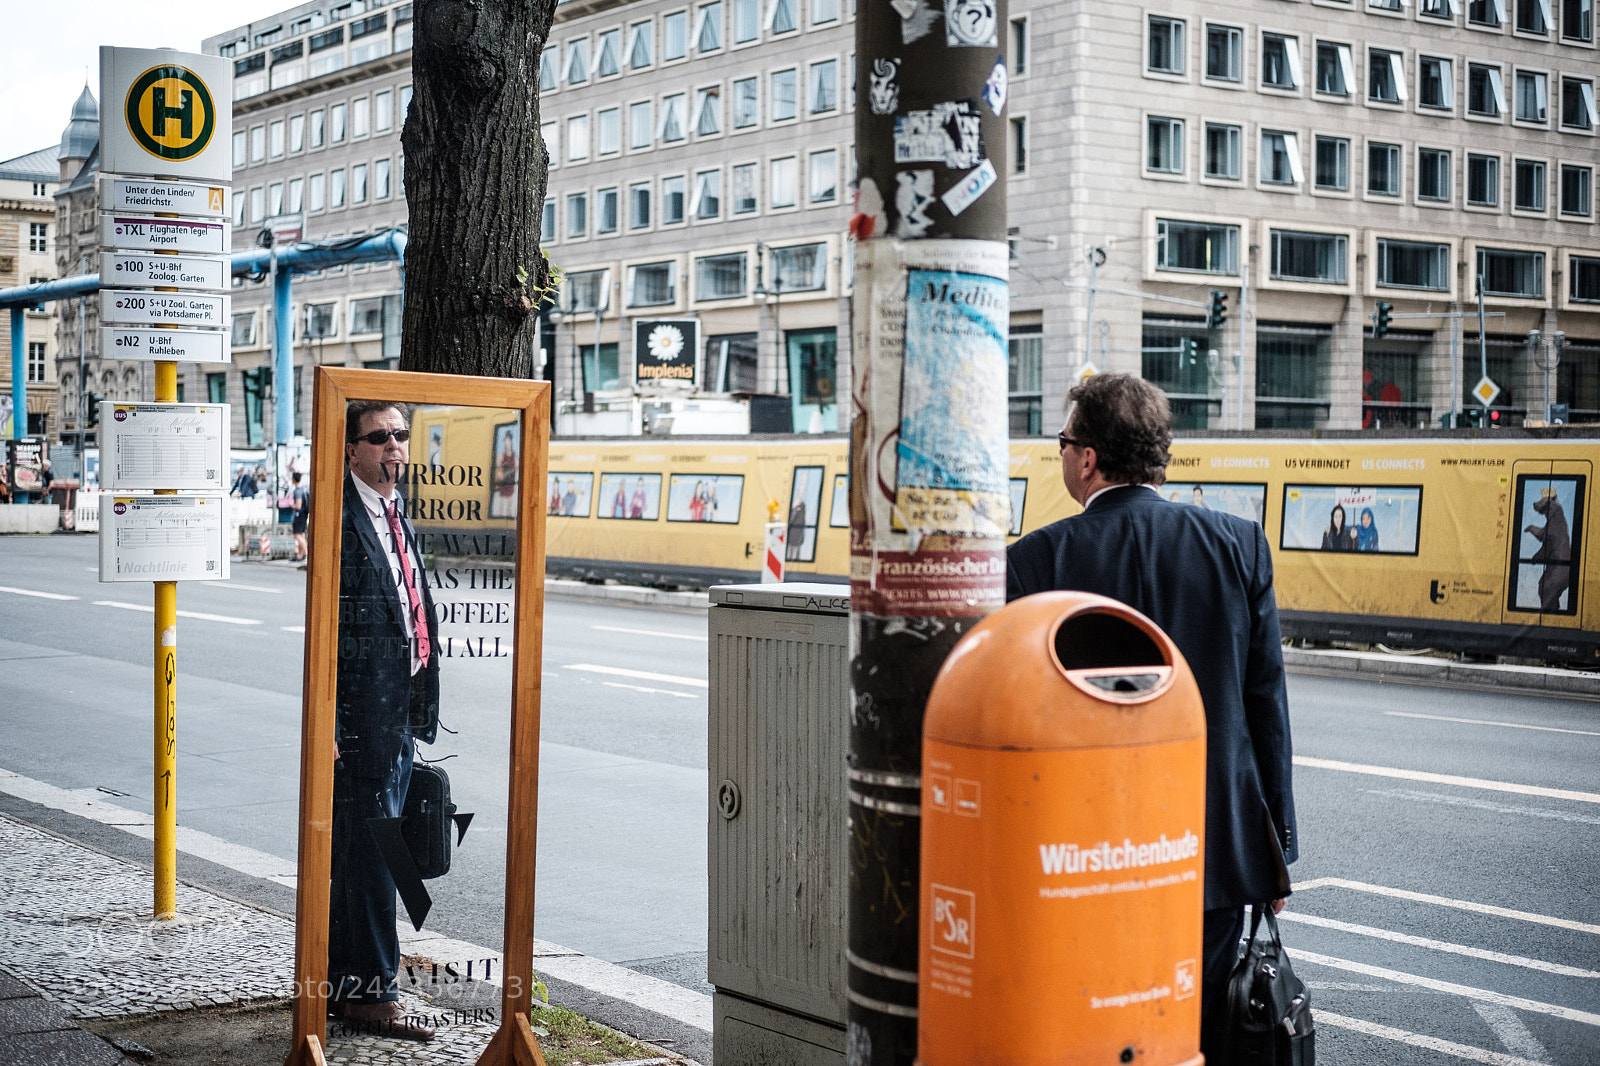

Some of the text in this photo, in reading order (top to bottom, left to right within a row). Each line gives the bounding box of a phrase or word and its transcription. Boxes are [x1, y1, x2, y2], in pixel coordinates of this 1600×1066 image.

[152, 86, 194, 140] H
[125, 185, 195, 200] Unter den Linden/
[125, 196, 174, 207] Friedrichstr.
[210, 191, 222, 211] A
[123, 224, 145, 236] TXL
[150, 225, 188, 237] Flughafen
[190, 226, 208, 239] Tegel
[149, 235, 178, 247] Airport
[124, 260, 144, 273] 100
[149, 261, 182, 273] S+U-Bhf
[149, 271, 205, 285] Zoolog. Garten
[124, 297, 145, 310] 200
[149, 299, 167, 308] S+U
[169, 300, 188, 309] Zool.
[189, 301, 213, 311] Garten
[149, 308, 213, 320] via Potsdamer Pl.
[124, 336, 140, 347] N2
[149, 336, 172, 345] U-Bhf
[149, 346, 185, 357] Ruhleben
[638, 362, 693, 379] Implenia
[114, 412, 127, 420] BUS
[1223, 457, 1270, 468] CONNECTS
[1299, 459, 1351, 470] VERBINDET
[1375, 458, 1426, 470] CONNECTS
[376, 461, 485, 488] MIRROR
[374, 496, 483, 522] MIRROR
[342, 530, 515, 558] ON THE WALL
[124, 560, 188, 576] Nachtlinie
[341, 566, 513, 590] WHO HAS THE
[807, 597, 851, 611] ALICE
[339, 600, 511, 625] BEST COFFEE
[339, 636, 509, 660] OF THEM ALL
[1039, 828, 1199, 875] Würstchenbude
[933, 896, 969, 946] BSR
[405, 956, 499, 986] VISIT
[404, 1006, 496, 1032] ROASTERS
